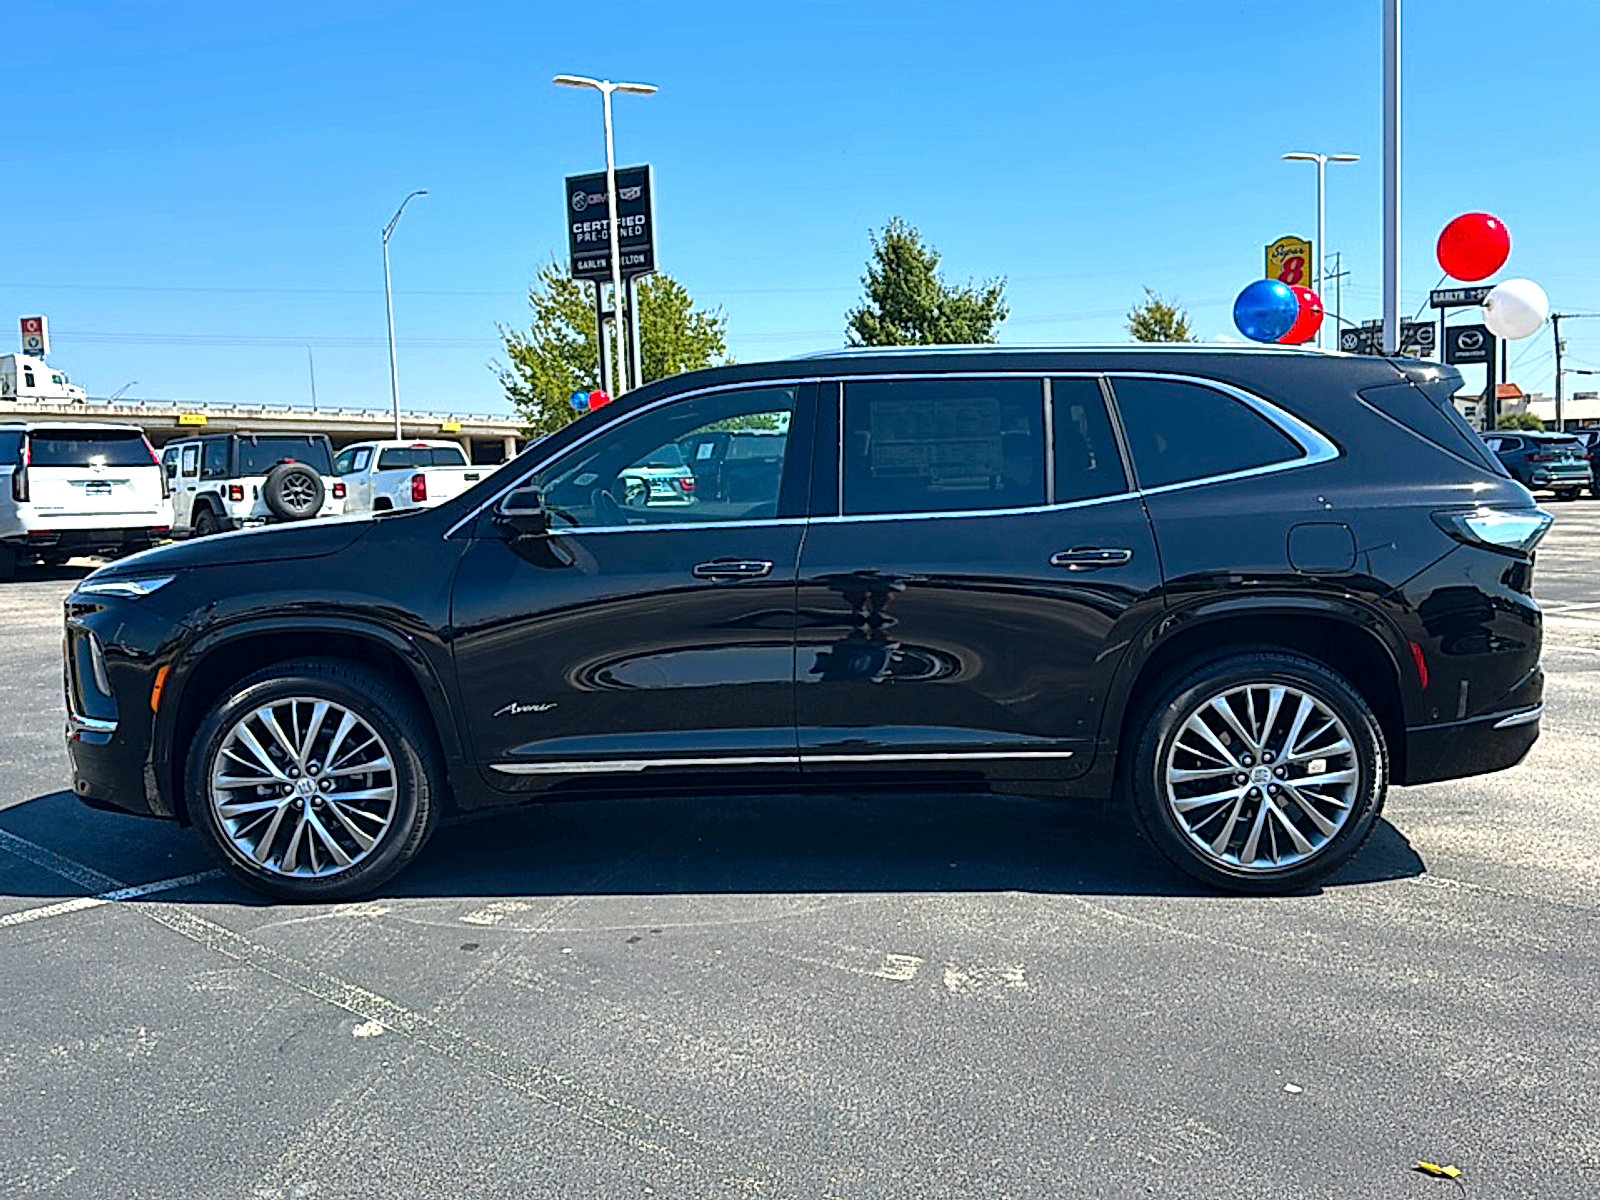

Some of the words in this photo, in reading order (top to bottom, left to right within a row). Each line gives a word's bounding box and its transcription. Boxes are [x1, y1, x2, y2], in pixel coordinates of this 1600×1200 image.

[587, 193, 610, 205] GM
[572, 214, 646, 233] CERTIED
[576, 225, 643, 243] PRE-ONED
[611, 254, 645, 266] ELTON
[1279, 256, 1305, 285] 8
